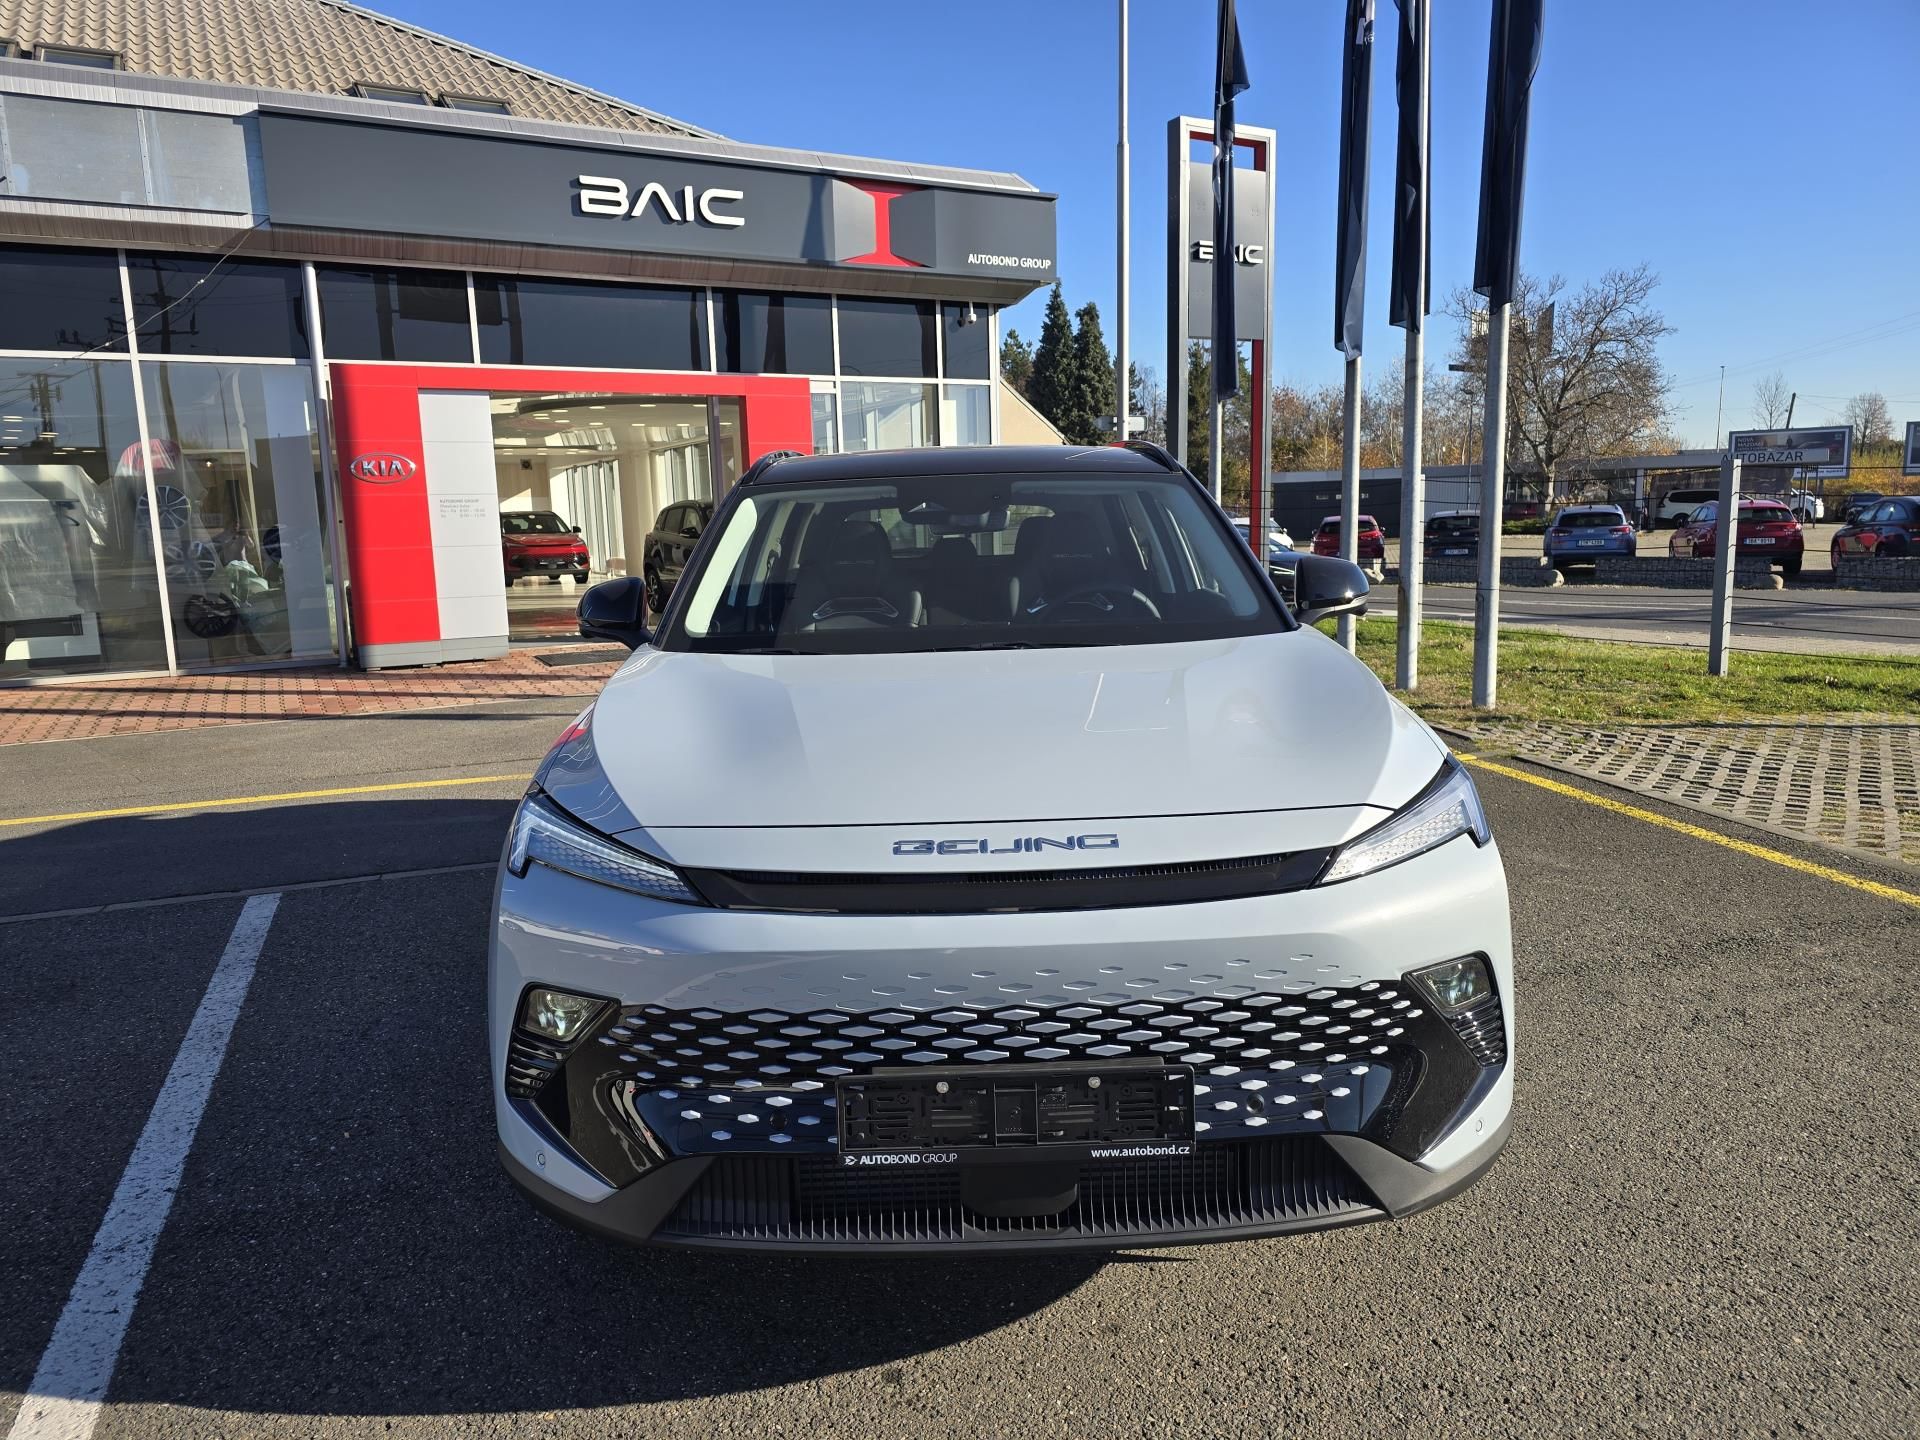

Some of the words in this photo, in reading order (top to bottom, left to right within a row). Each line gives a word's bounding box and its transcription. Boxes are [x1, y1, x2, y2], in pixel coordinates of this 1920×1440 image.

[579, 175, 745, 226] BAIC
[967, 253, 1019, 267] AUTOBOND
[1020, 257, 1052, 270] GROUP
[1199, 240, 1264, 264] BIC
[1721, 451, 1804, 464] AUTOBAZAR
[362, 460, 406, 477] KIA
[892, 833, 1120, 856] BEIJING
[859, 1153, 921, 1165] AUTOBOND
[922, 1152, 958, 1163] GROUP
[1091, 1144, 1190, 1158] www.autobond.cz
